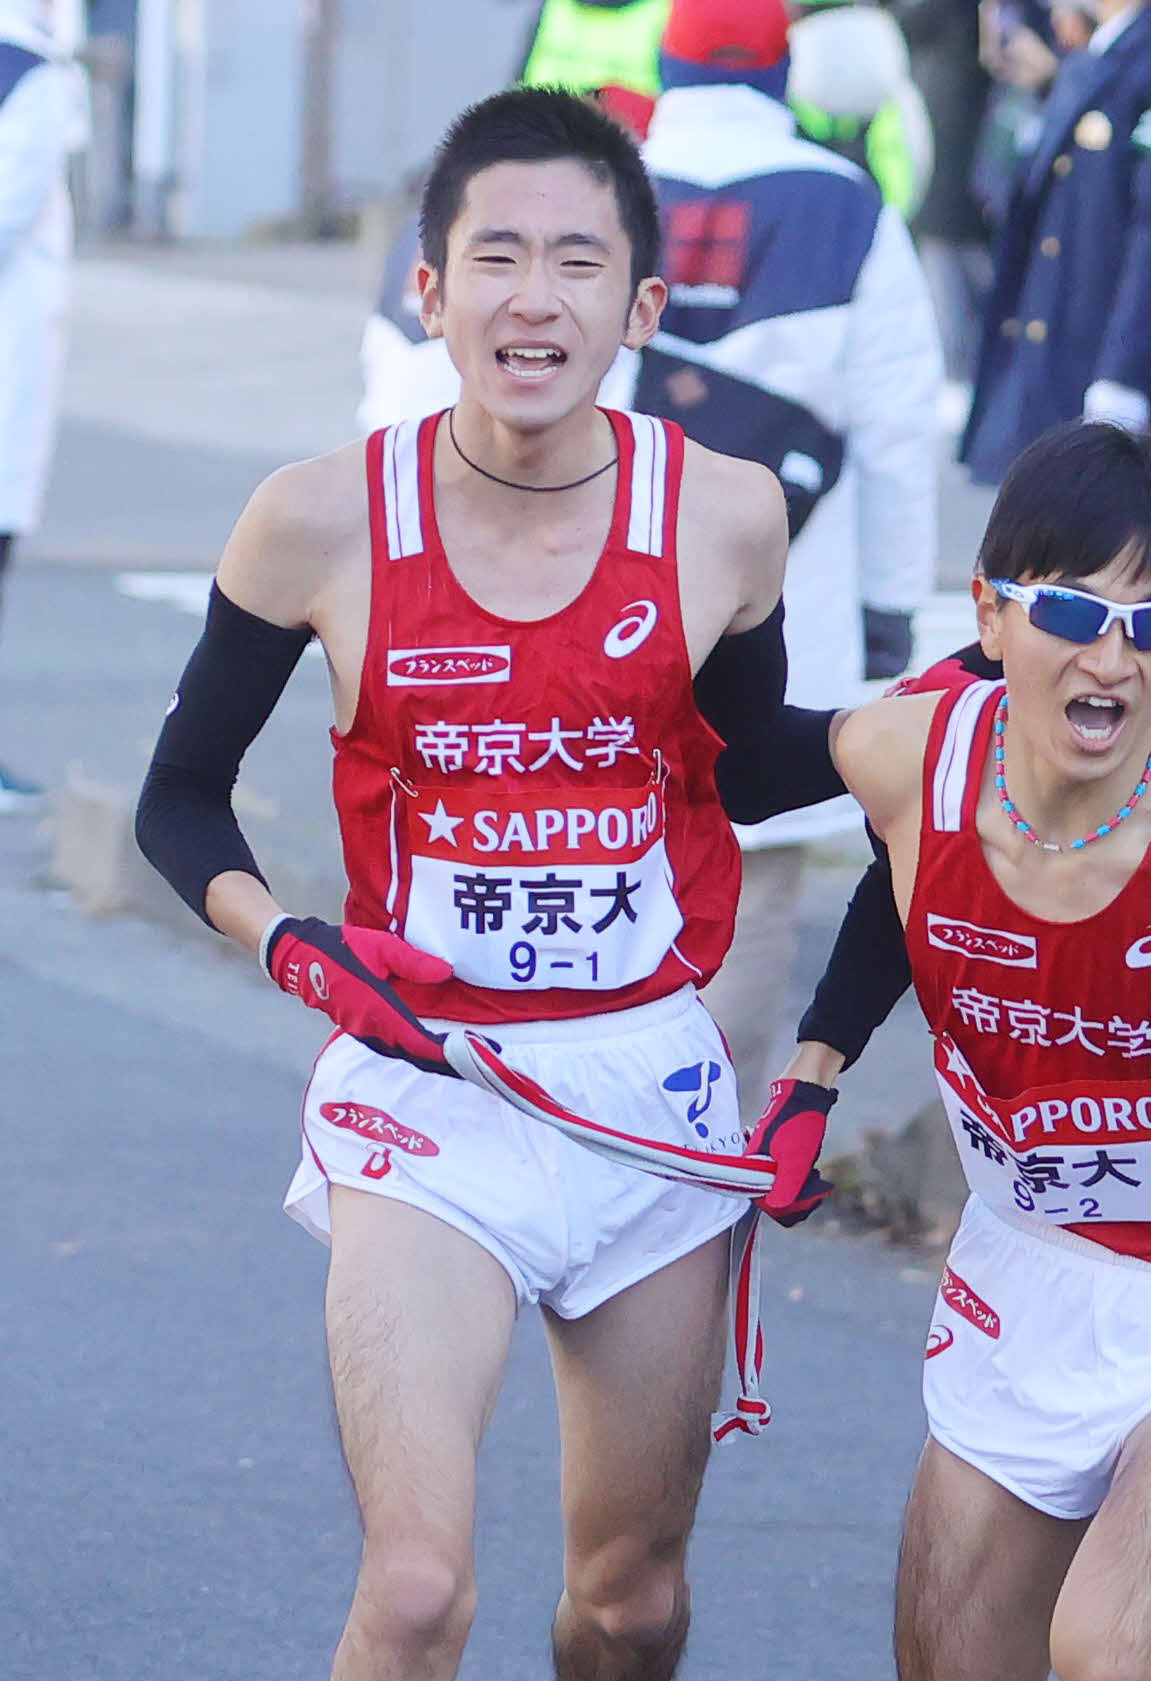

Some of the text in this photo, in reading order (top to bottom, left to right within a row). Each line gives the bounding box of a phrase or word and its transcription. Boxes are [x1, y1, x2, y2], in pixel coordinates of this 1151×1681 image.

[415, 716, 641, 777] 帝京大学
[472, 791, 658, 853] SAPPORO
[453, 872, 643, 936] 帝京大
